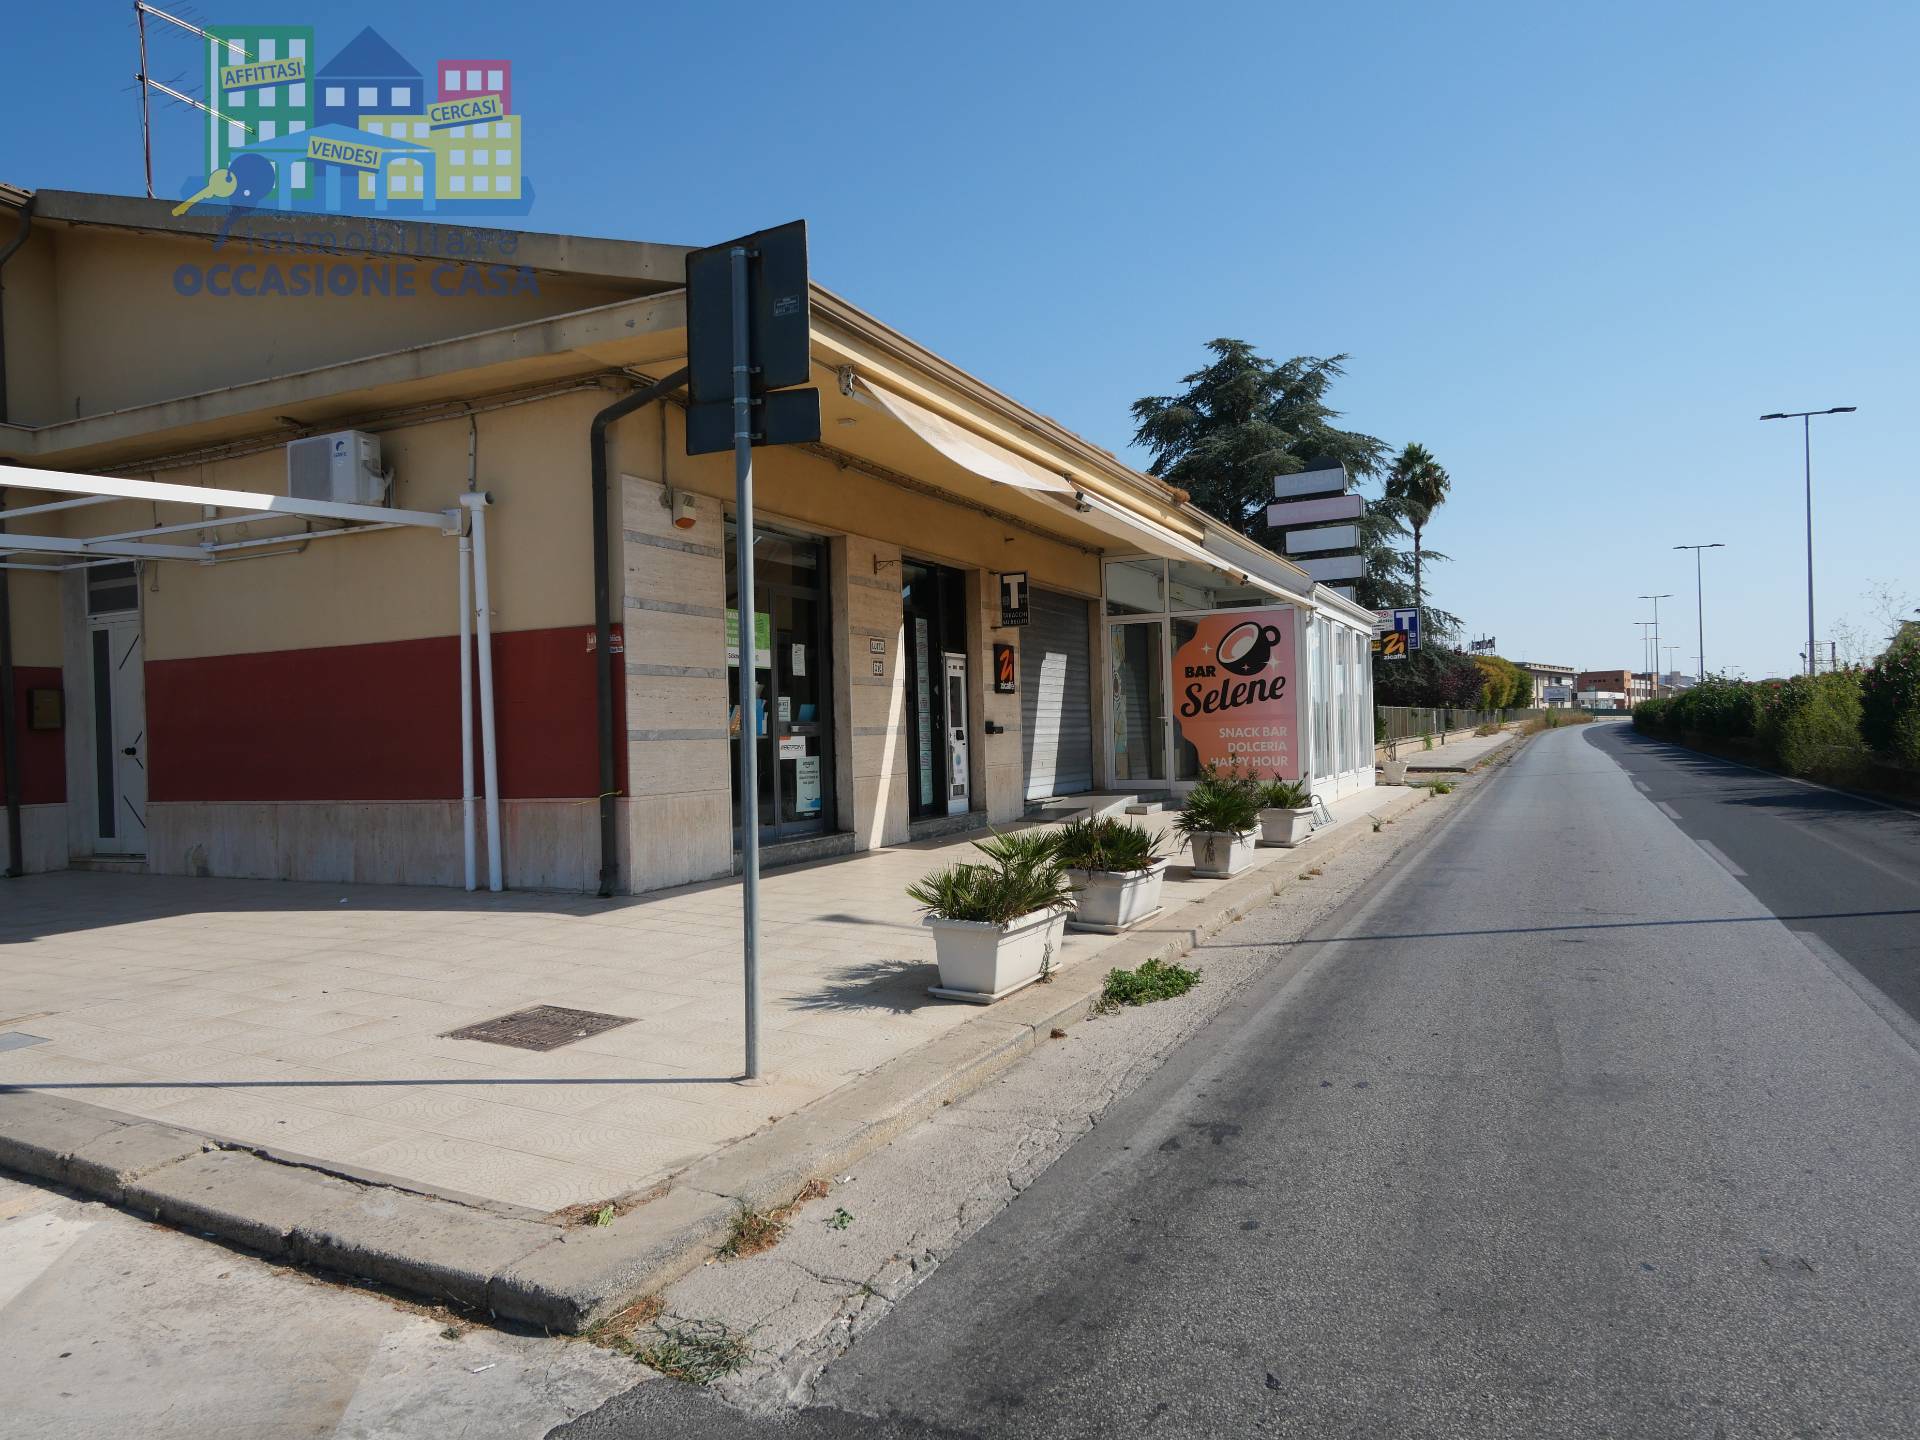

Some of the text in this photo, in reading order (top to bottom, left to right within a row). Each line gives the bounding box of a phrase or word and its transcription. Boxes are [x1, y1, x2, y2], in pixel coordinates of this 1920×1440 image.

[1184, 665, 1216, 678] BAR
[1180, 676, 1286, 718] Selene
[1219, 727, 1287, 739] SNACK BAR
[1227, 741, 1287, 753] DOLCERIA
[1210, 755, 1288, 768] HAPPY HOUR
